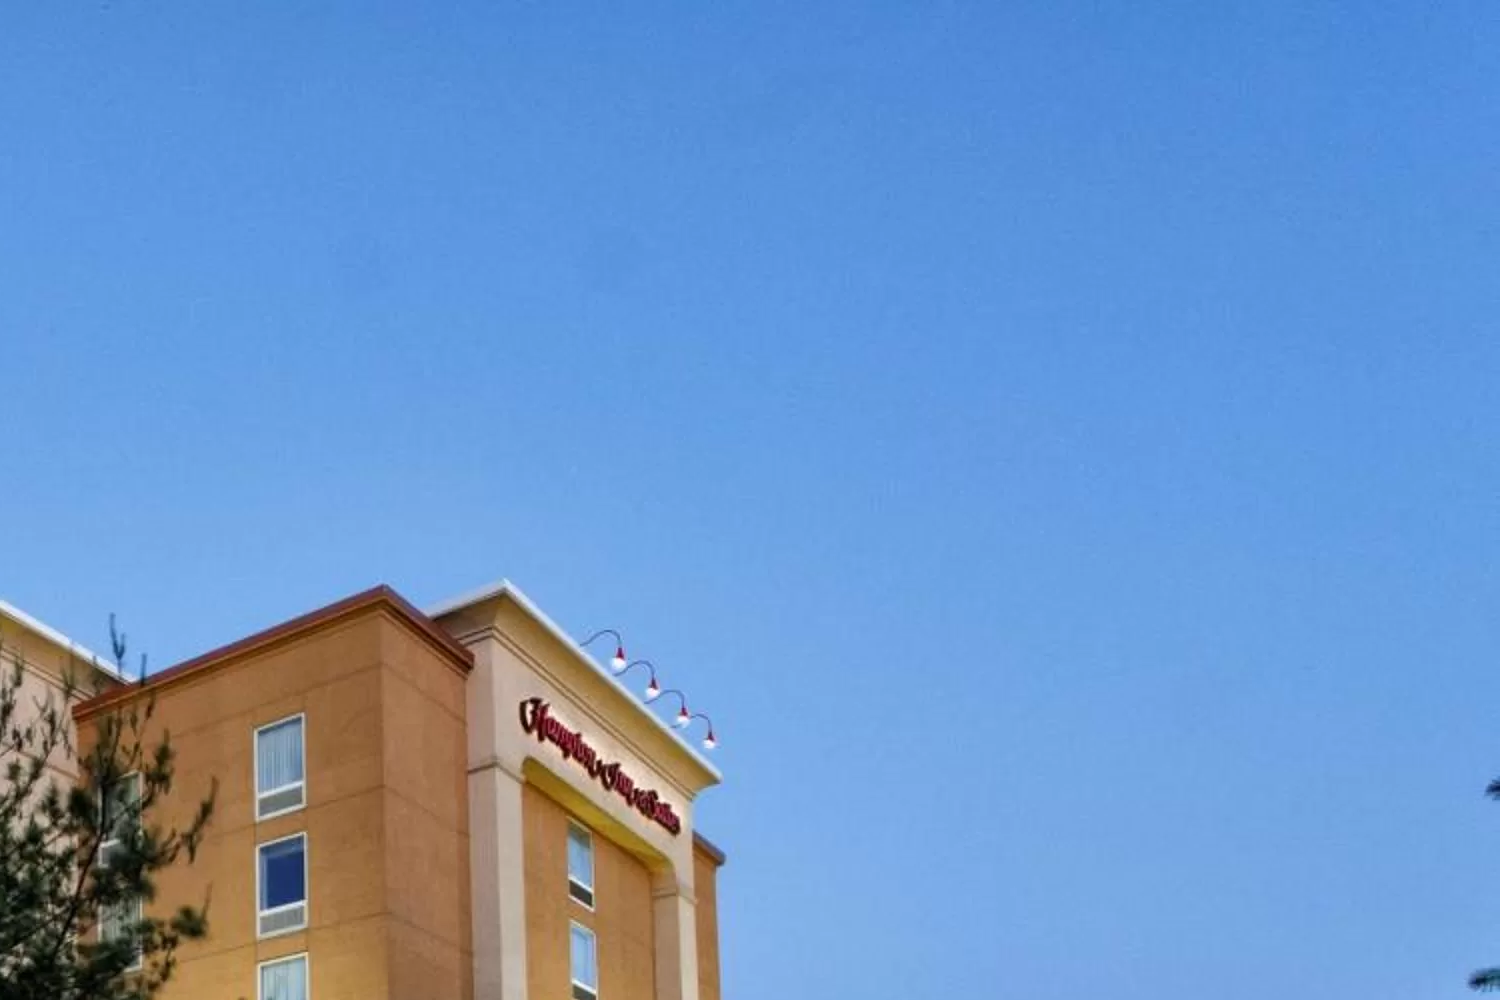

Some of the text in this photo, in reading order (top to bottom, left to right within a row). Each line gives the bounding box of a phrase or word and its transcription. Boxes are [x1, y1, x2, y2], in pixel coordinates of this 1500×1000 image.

[519, 697, 602, 780] Hampton
[599, 762, 638, 807] Inn
[644, 789, 681, 835] Suites
